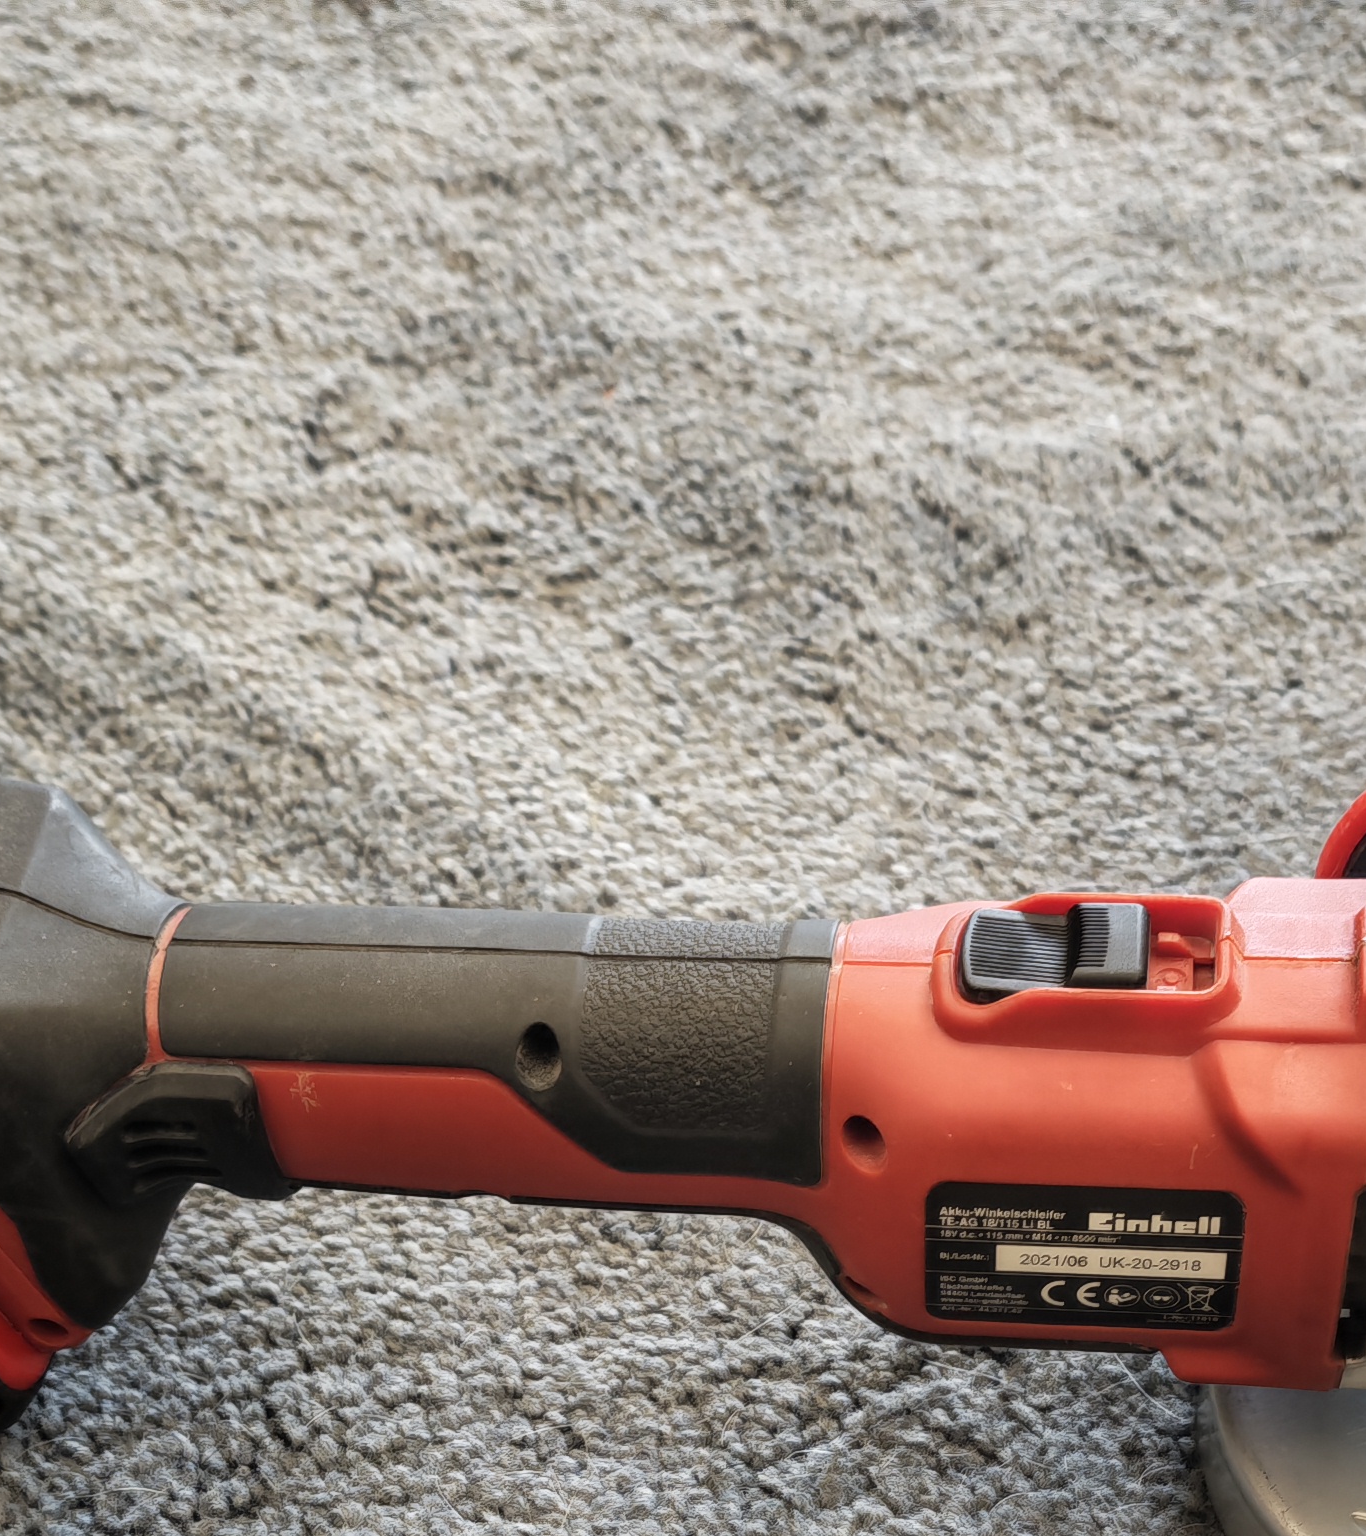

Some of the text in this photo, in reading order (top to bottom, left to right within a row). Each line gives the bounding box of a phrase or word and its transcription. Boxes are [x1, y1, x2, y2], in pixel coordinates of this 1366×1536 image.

[939, 1206, 1067, 1221] Akku-Winkelschleifer
[939, 1216, 978, 1228] TE-AG
[981, 1218, 1020, 1229] 18/115
[1037, 1220, 1055, 1230] BL
[1088, 1212, 1222, 1235] Einhell
[1019, 1253, 1202, 1271] 2021/06 UK-20-2918
